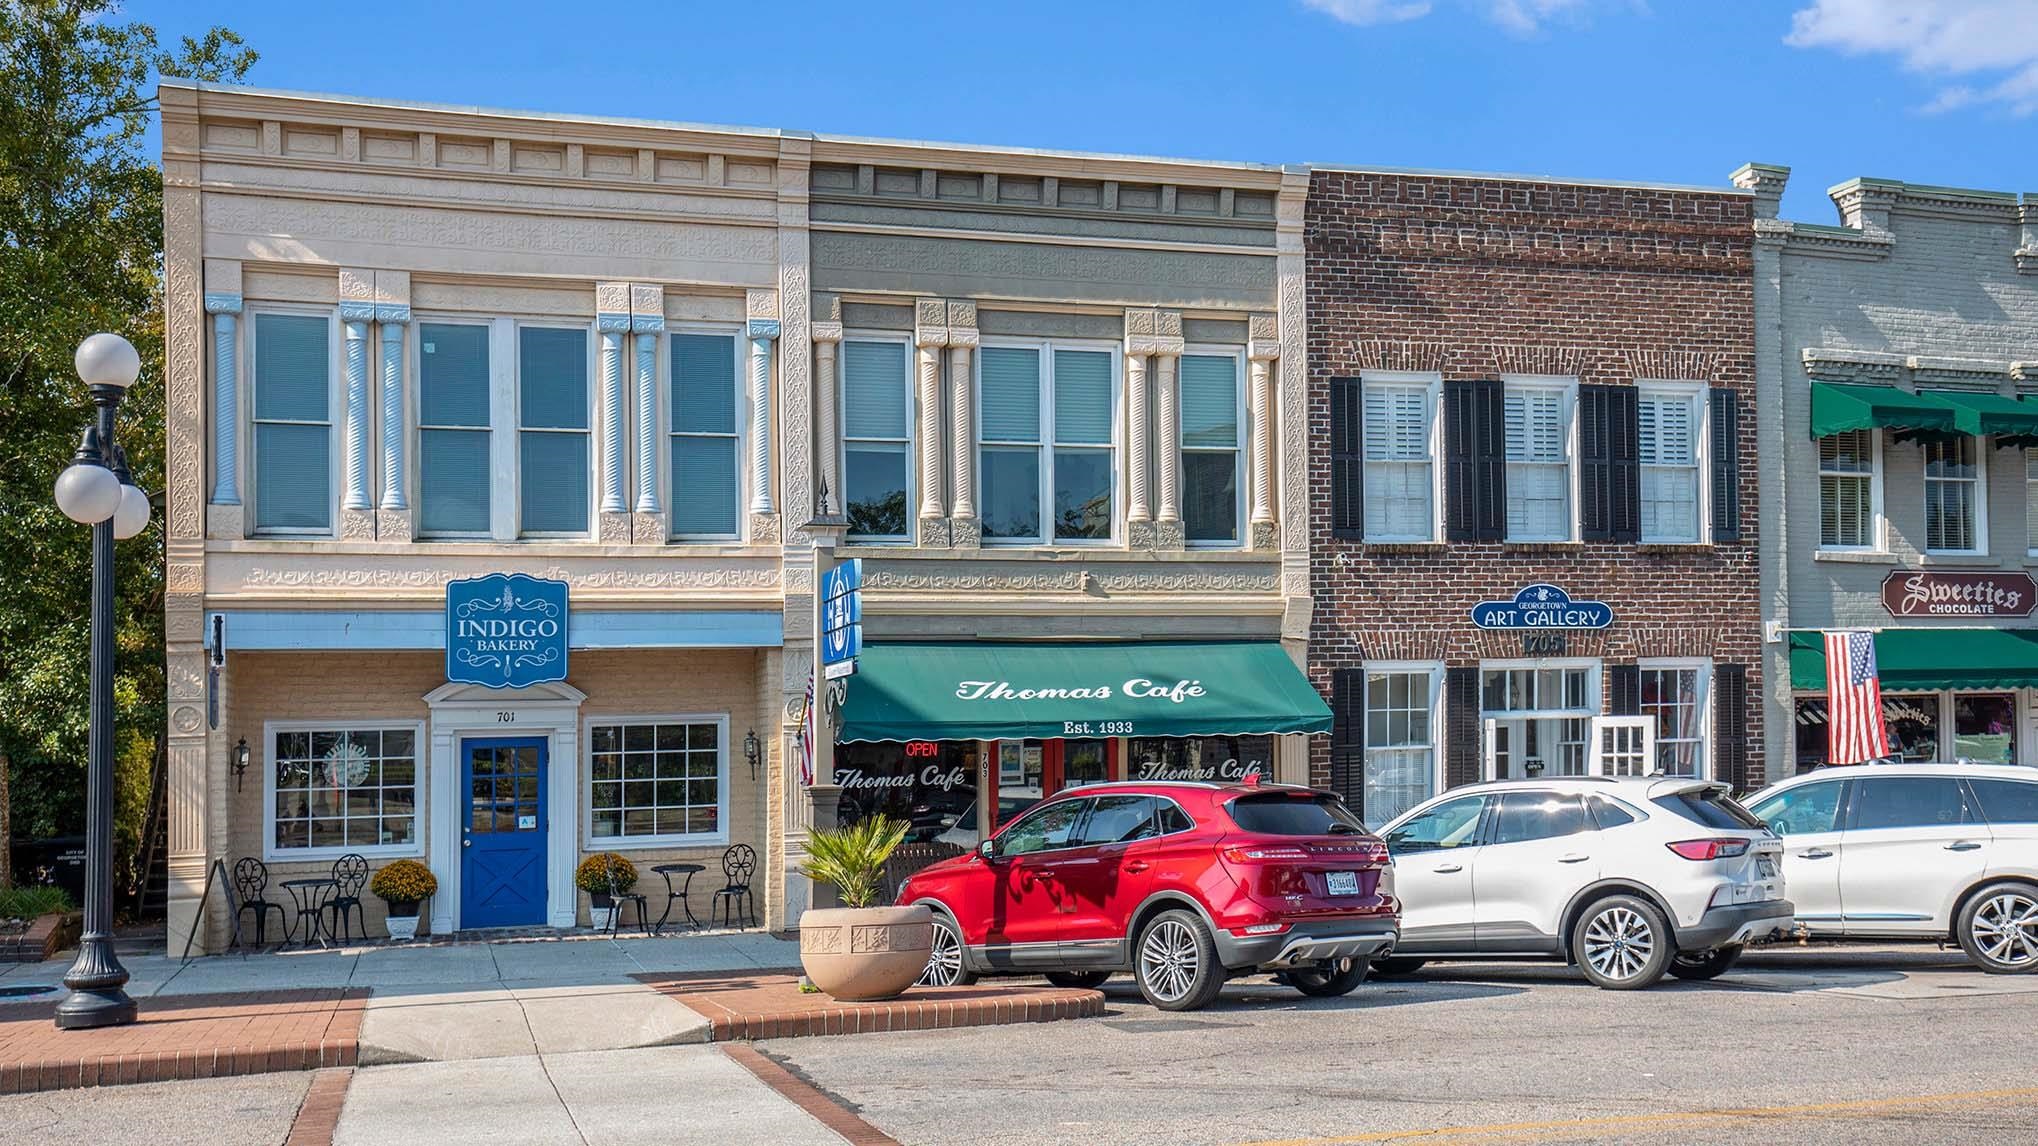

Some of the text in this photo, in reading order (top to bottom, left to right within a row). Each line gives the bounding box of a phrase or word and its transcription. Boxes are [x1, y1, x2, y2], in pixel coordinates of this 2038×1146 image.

[1901, 573, 2022, 614] Sweeties
[1518, 602, 1567, 610] GEORGETOWN
[1929, 604, 1994, 613] CHOCOLATE
[1484, 610, 1600, 625] ART GALLERY
[457, 619, 558, 637] INDIGO
[477, 640, 538, 651] BAKERY
[1529, 633, 1561, 651] 705
[956, 678, 1207, 703] Thomas Café
[497, 711, 515, 723] 701
[1063, 721, 1133, 734] Est. 1933
[905, 742, 938, 757] OPEN
[834, 764, 966, 792] Thomas Café
[1138, 761, 1215, 781] Thomas
